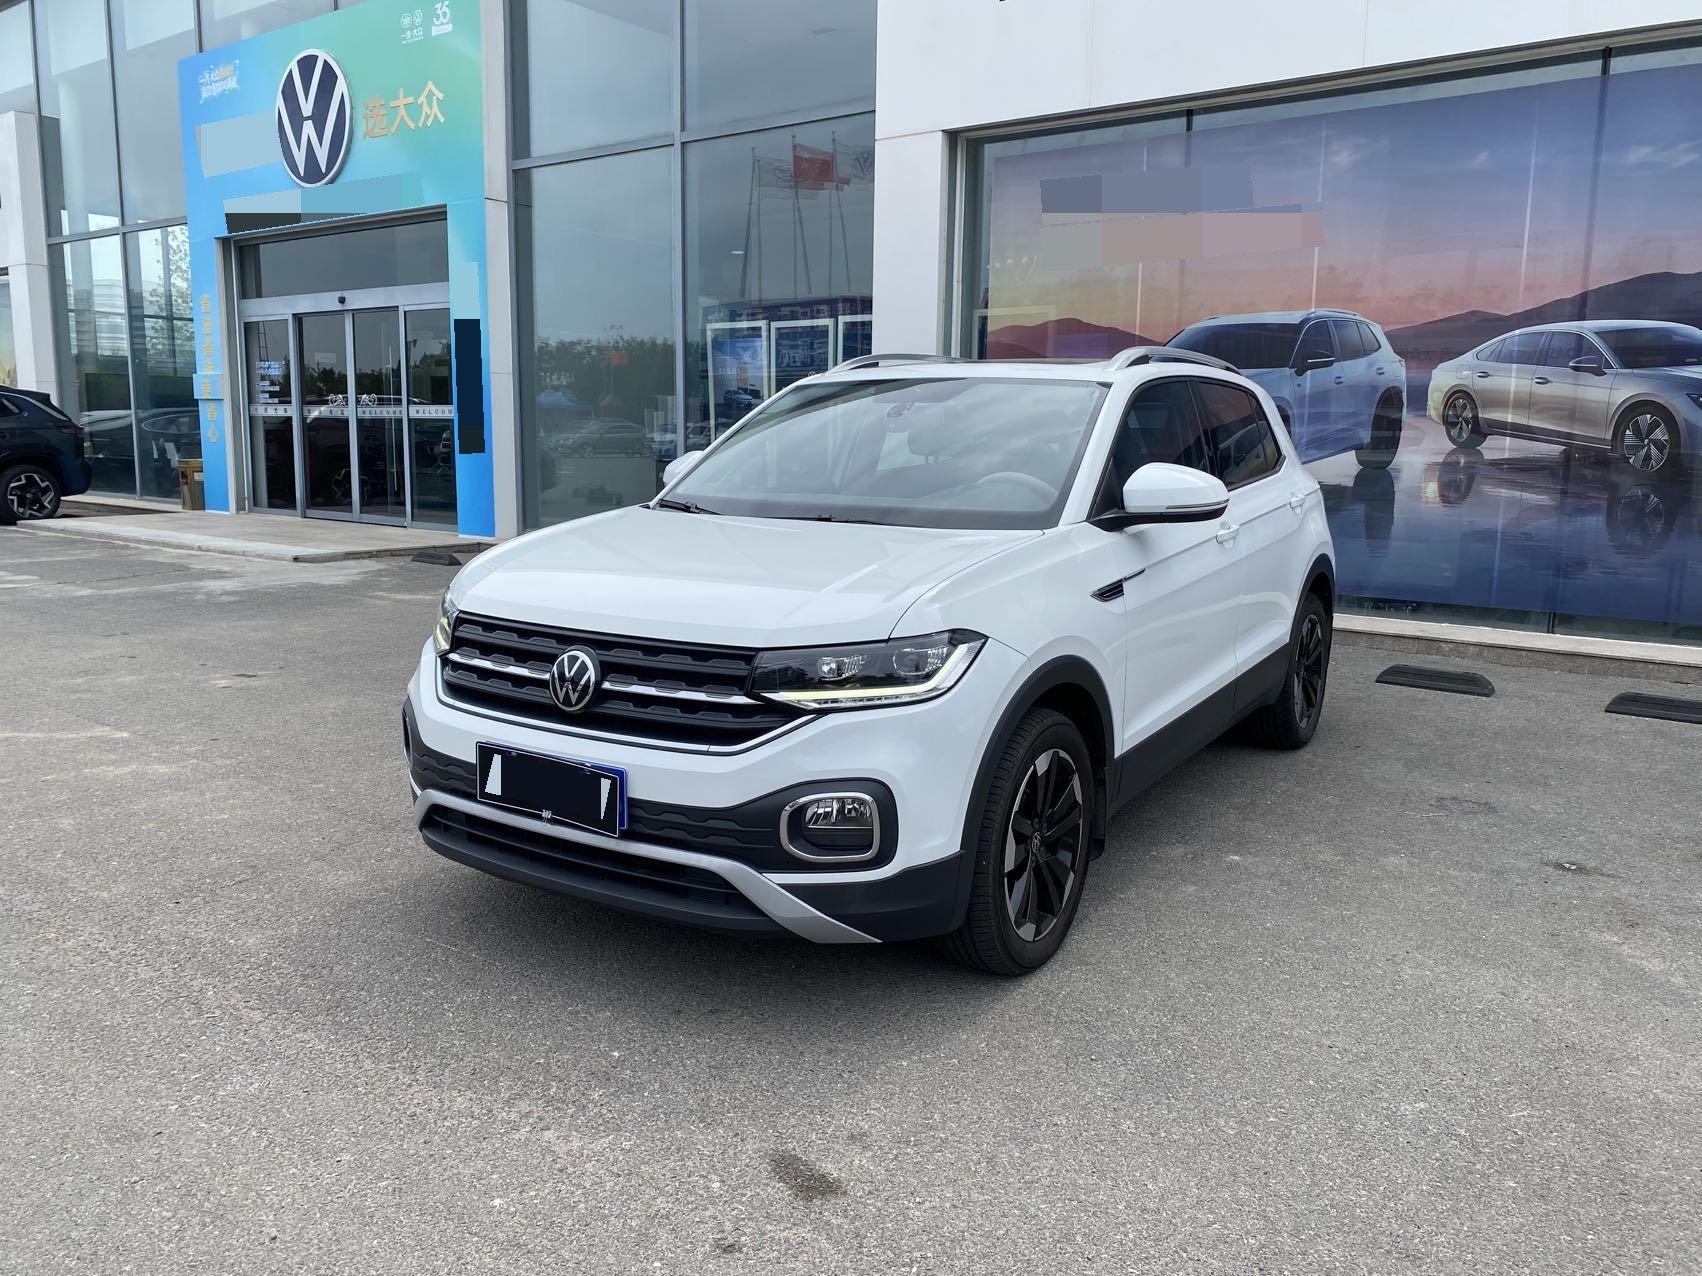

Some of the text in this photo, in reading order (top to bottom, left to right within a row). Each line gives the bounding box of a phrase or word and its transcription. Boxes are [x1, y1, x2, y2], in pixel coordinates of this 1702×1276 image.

[433, 0, 451, 25] 35
[362, 80, 445, 139] 选大众
